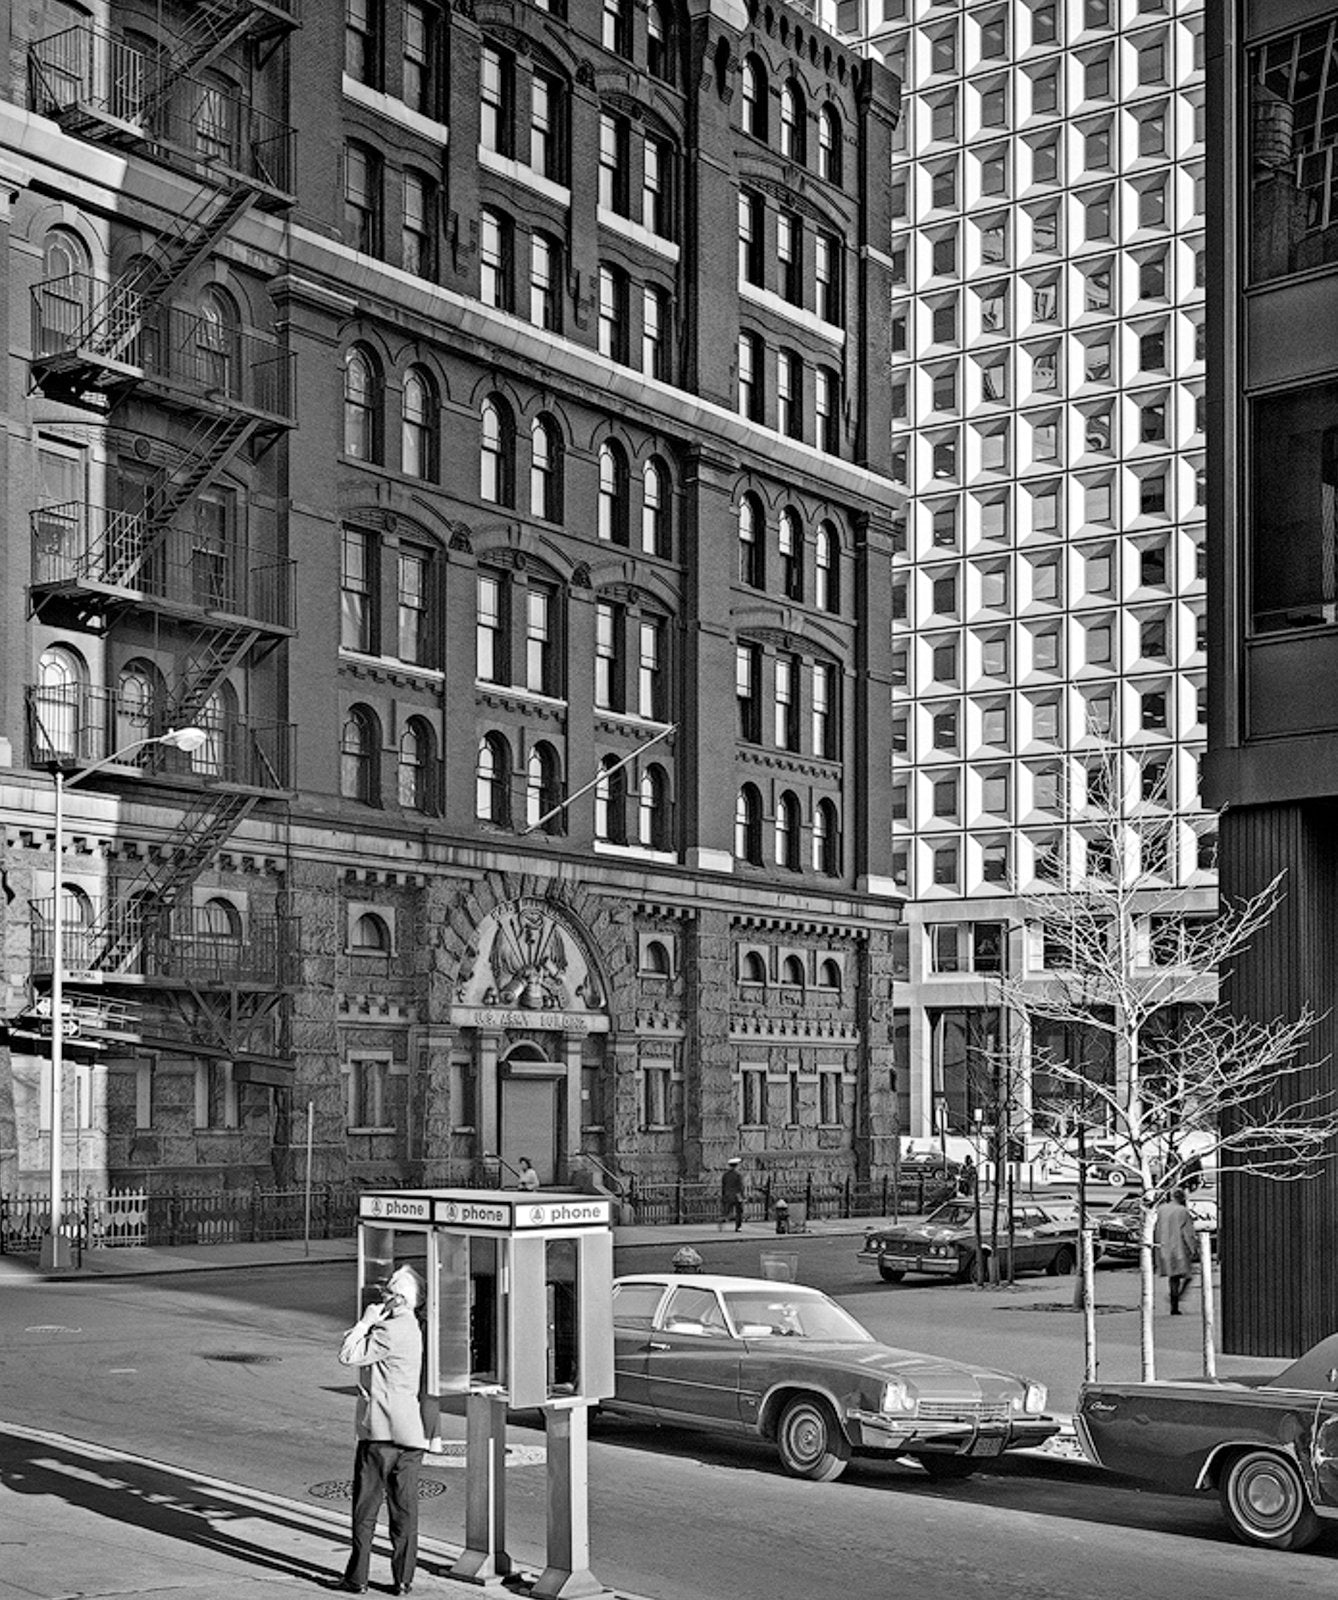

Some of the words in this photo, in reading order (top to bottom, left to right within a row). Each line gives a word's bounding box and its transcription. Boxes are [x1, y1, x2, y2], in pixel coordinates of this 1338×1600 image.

[386, 1200, 424, 1216] phone
[462, 1205, 503, 1222] phone
[551, 1205, 601, 1222] phone
